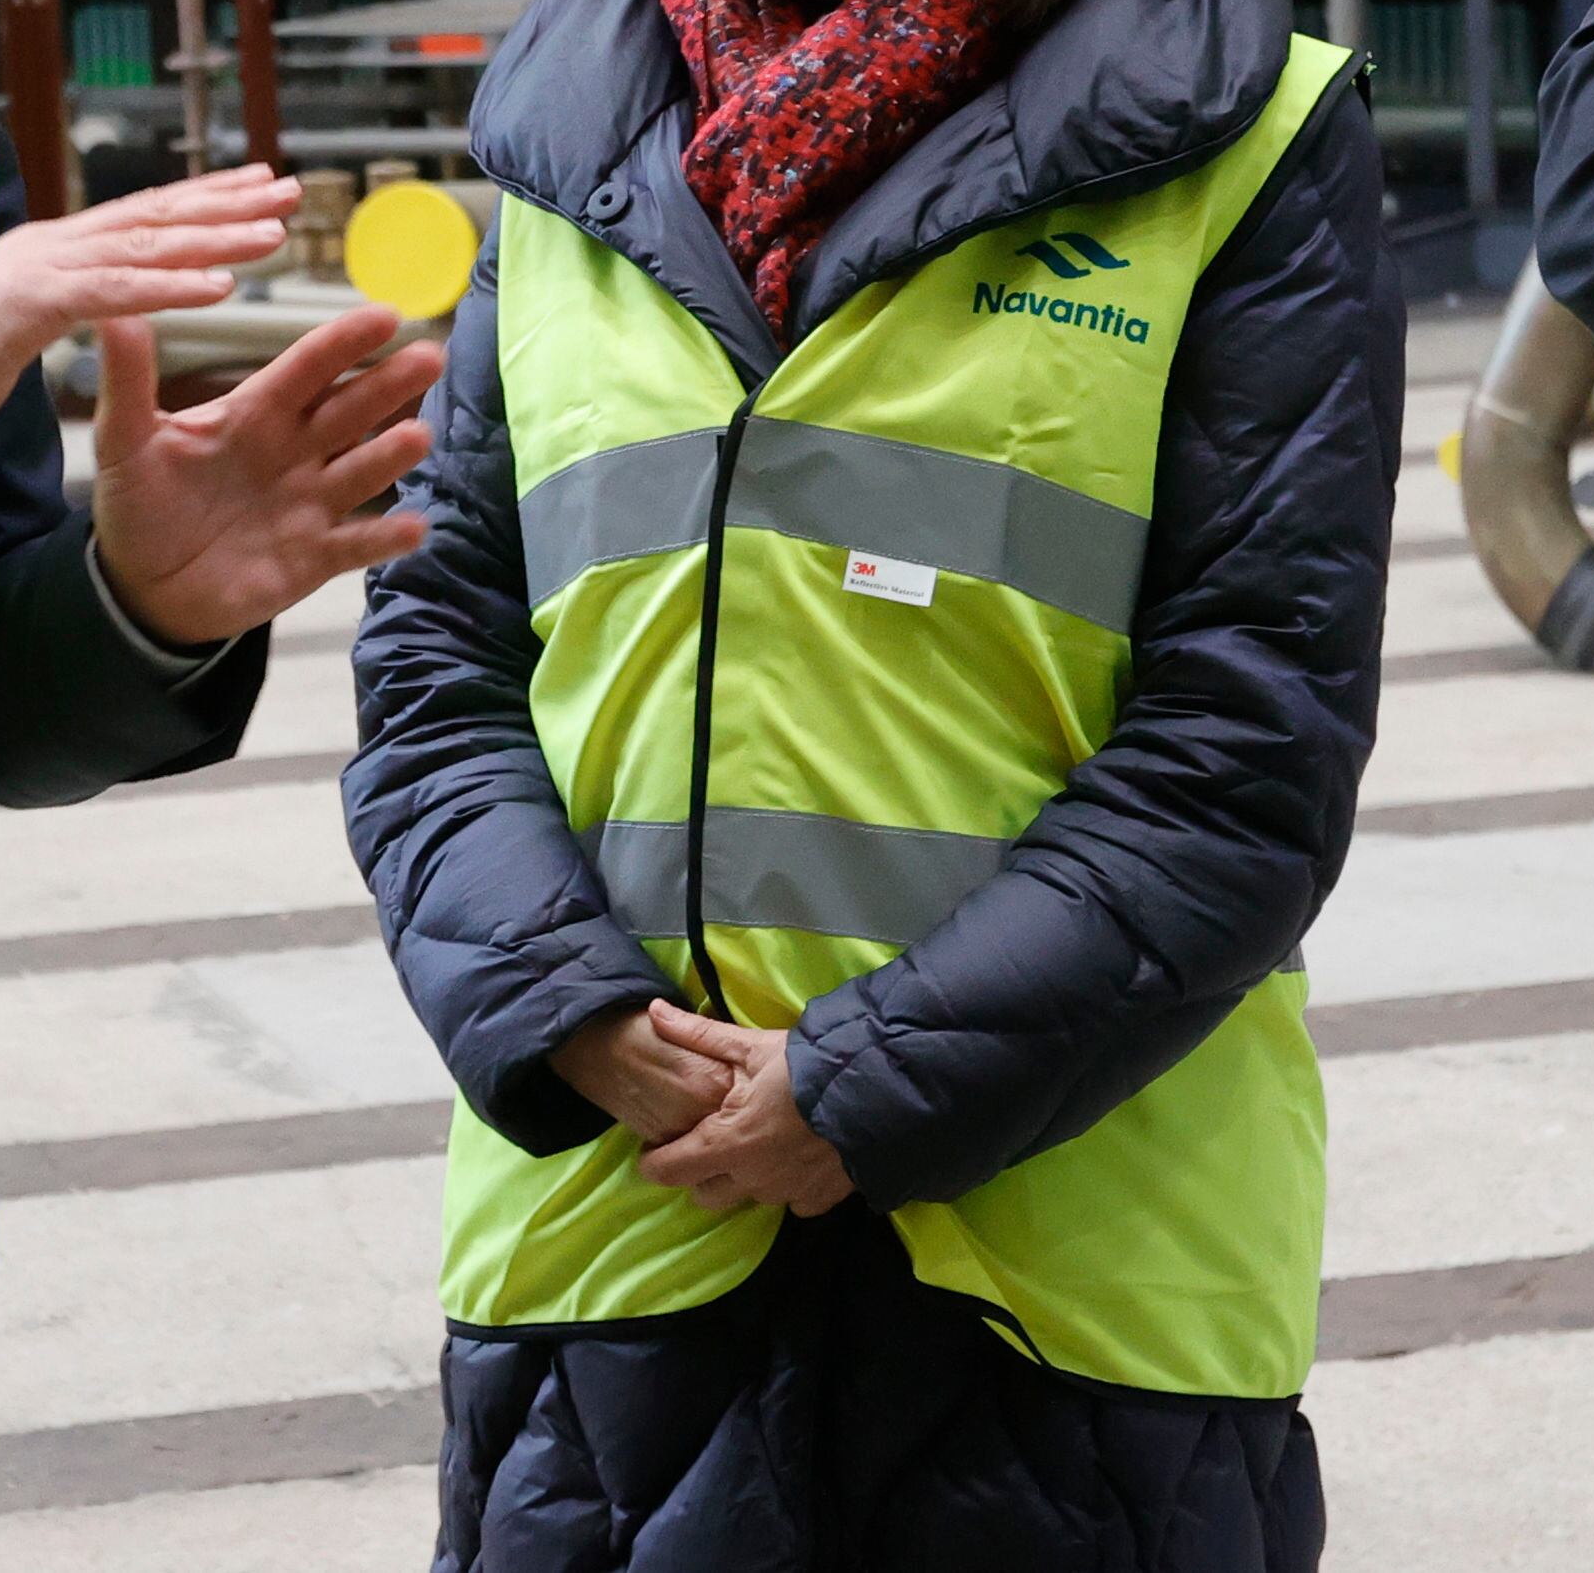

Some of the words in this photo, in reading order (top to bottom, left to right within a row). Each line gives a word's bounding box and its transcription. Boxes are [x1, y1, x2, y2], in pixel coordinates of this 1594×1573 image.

[972, 282, 1149, 344] Navantia
[852, 562, 876, 577] 3M
[850, 578, 888, 591] Reflective
[891, 585, 925, 598] Material
